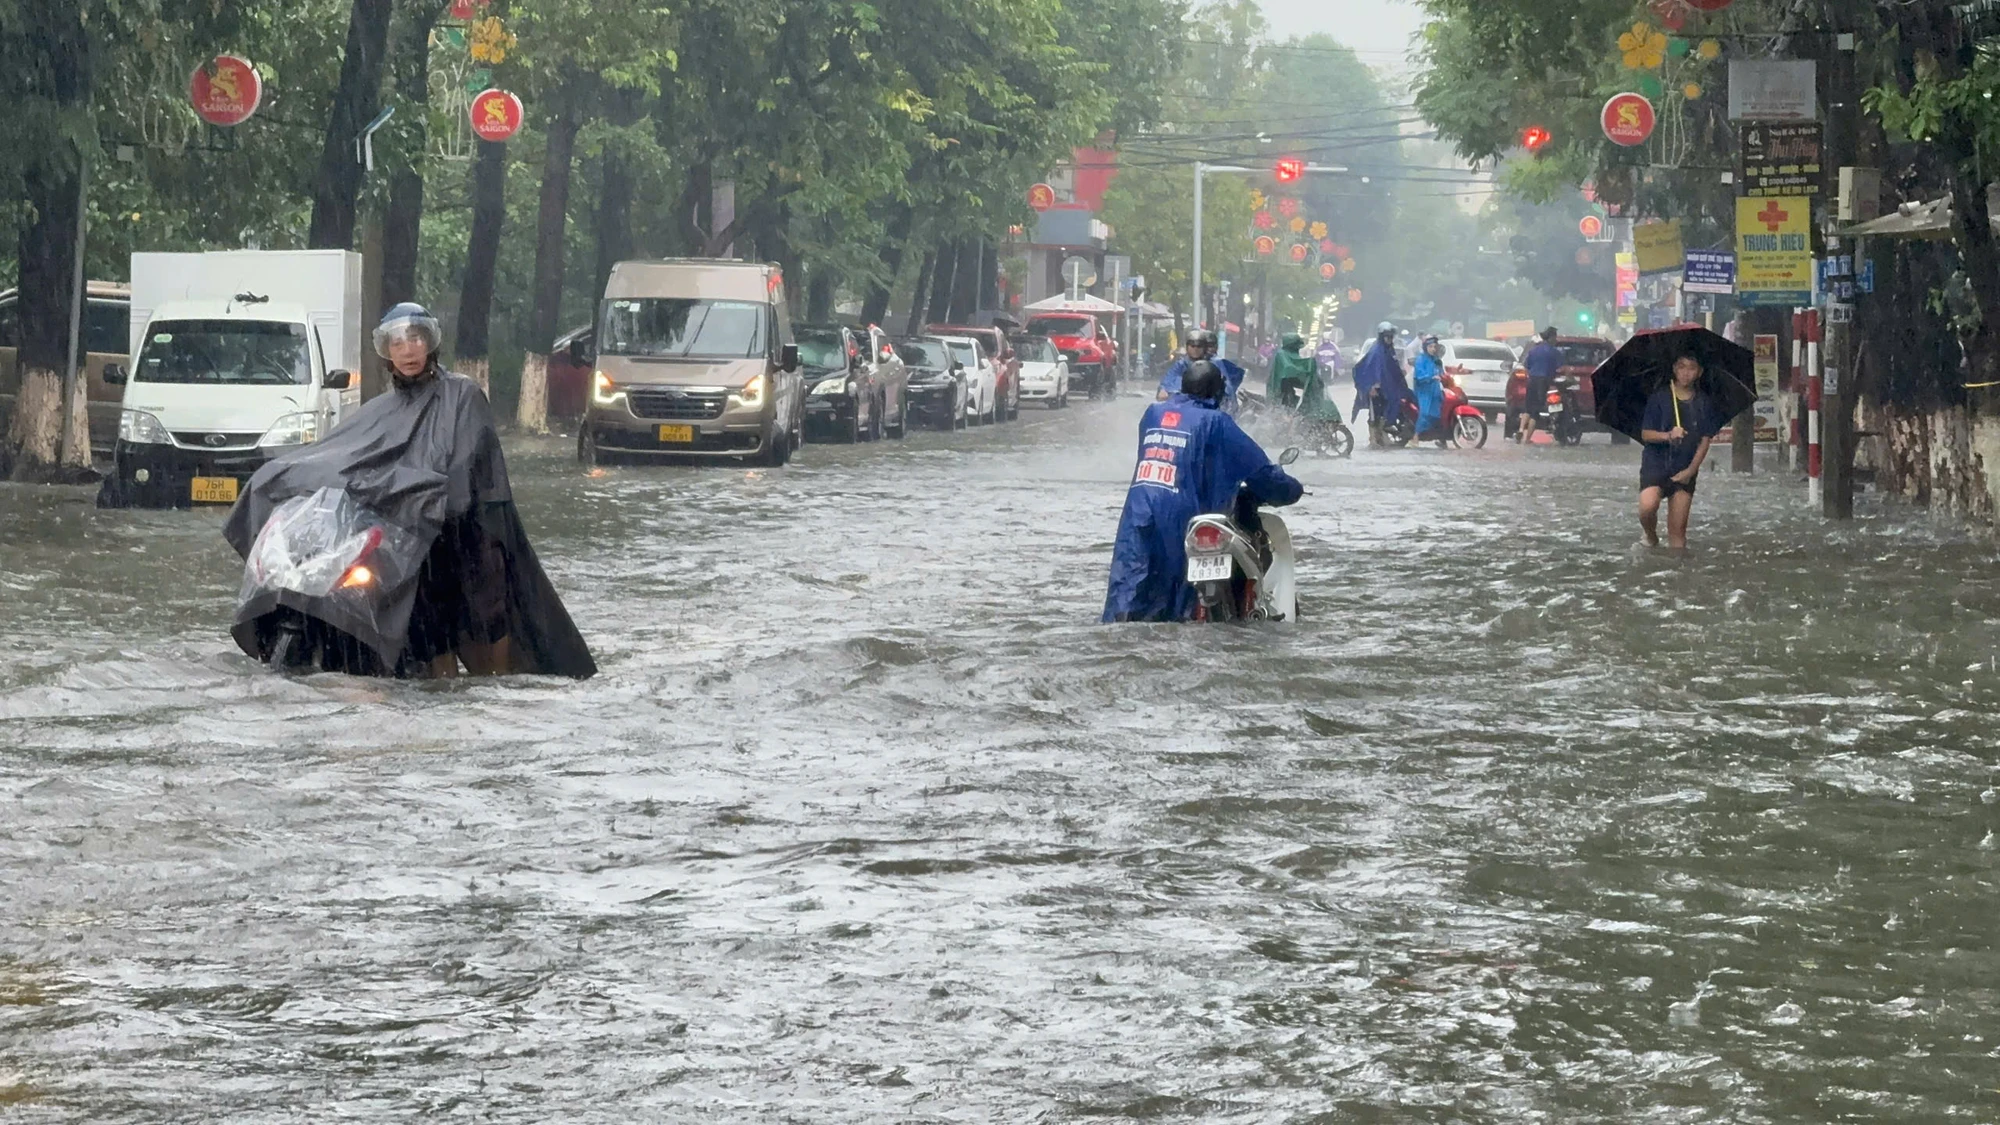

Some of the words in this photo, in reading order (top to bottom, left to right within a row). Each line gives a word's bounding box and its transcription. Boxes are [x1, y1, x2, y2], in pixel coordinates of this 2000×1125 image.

[202, 103, 244, 112] SAIGON
[480, 124, 510, 132] SAIGON
[1610, 127, 1642, 136] SAIGON
[1743, 234, 1777, 251] TRUNG
[205, 480, 225, 490] 76H
[1195, 556, 1225, 568] 76-AA
